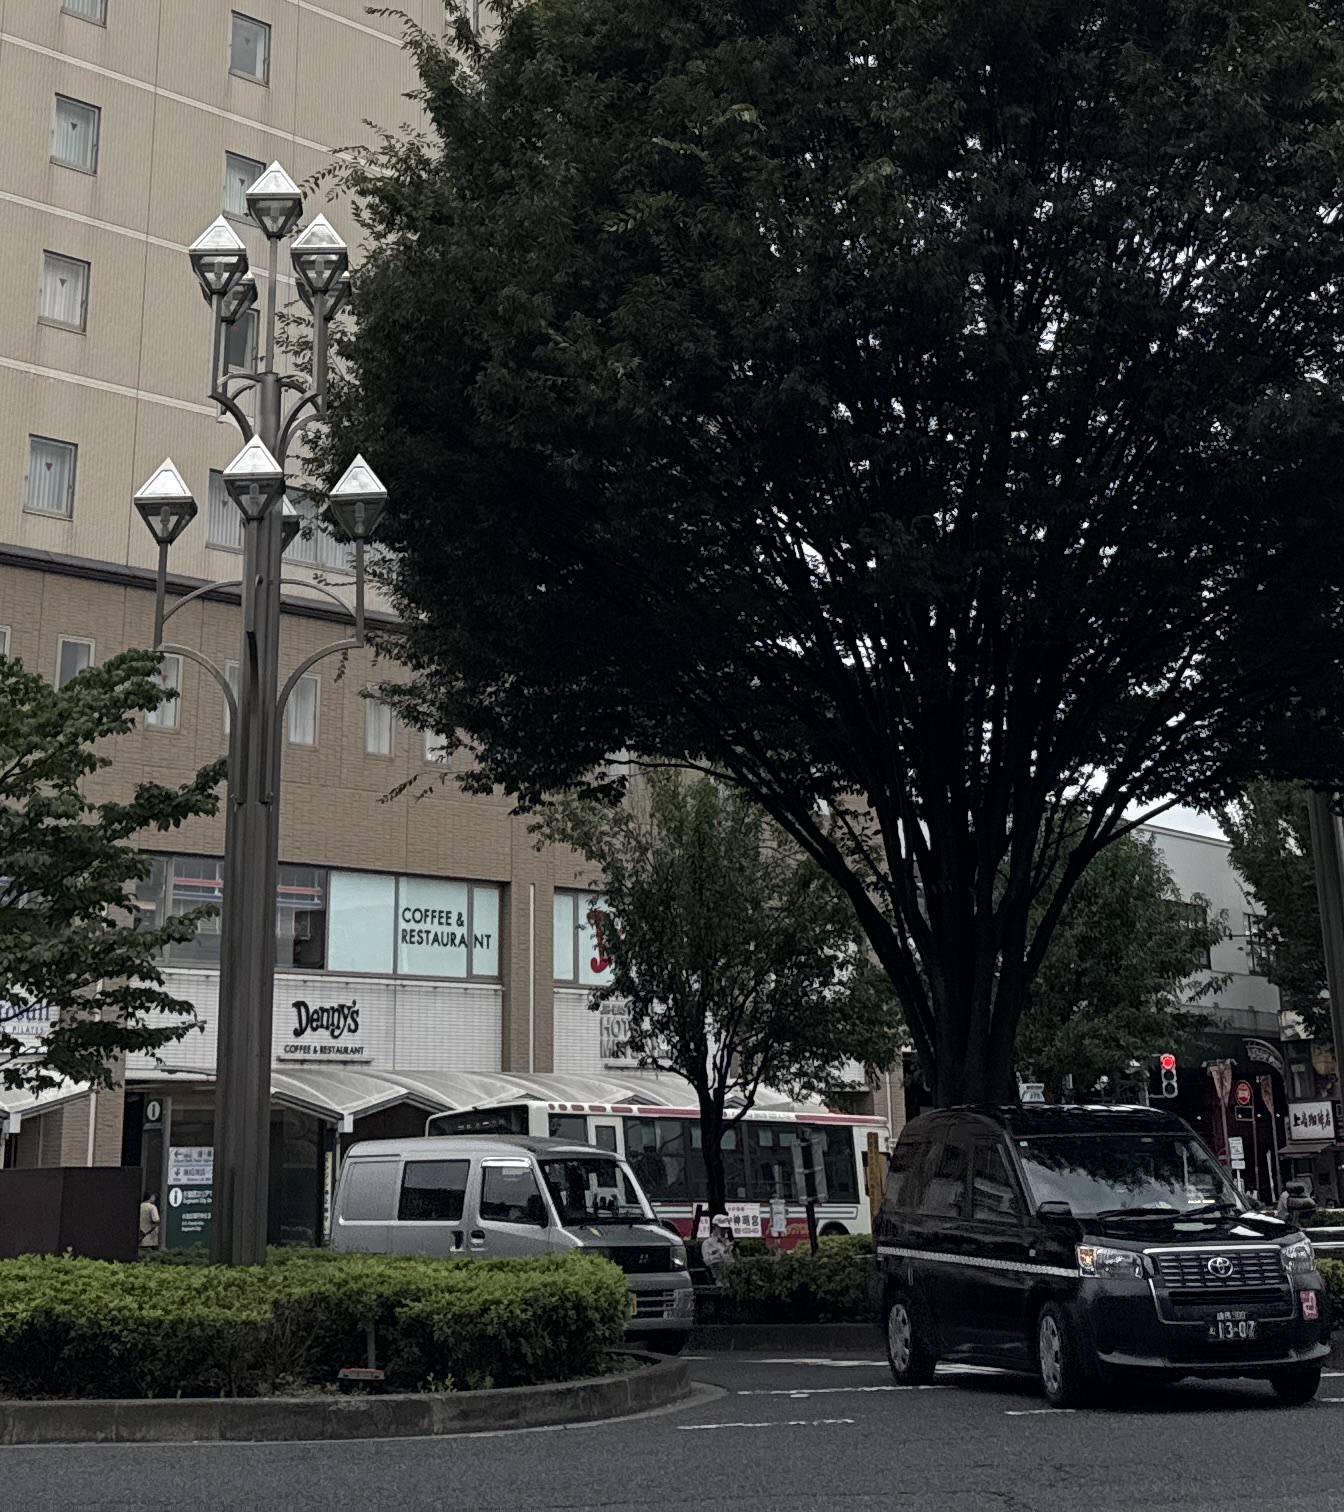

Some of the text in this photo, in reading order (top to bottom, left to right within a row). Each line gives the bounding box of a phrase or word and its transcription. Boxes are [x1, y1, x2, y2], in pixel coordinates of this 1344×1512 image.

[401, 908, 465, 927] COFFEE &
[401, 929, 492, 950] RESTAURANT
[292, 999, 359, 1038] Denny's
[284, 1044, 311, 1054] COFFEE
[320, 1045, 364, 1055] RESTAURANT
[1218, 1320, 1255, 1339] 13-07
